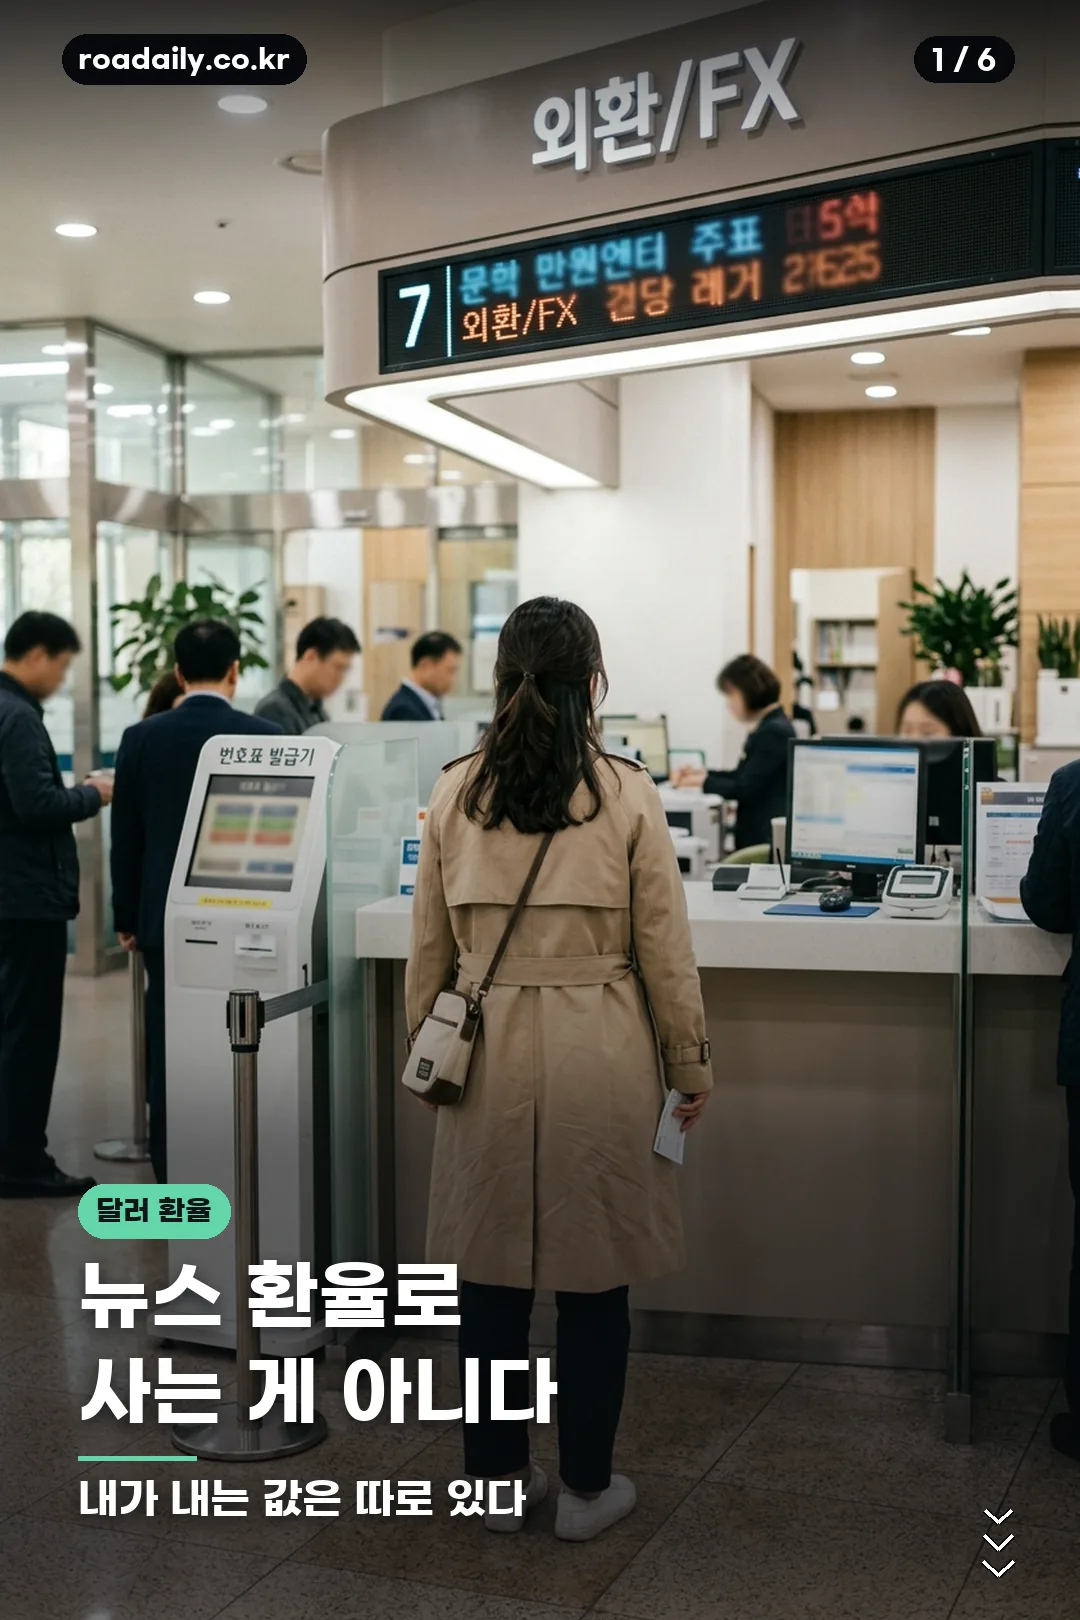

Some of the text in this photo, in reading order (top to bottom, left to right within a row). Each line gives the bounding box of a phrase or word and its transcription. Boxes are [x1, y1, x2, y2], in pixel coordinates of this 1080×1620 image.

[532, 37, 802, 172] 외환/FX
[399, 284, 430, 348] 7
[462, 293, 578, 343] 외환/FX
